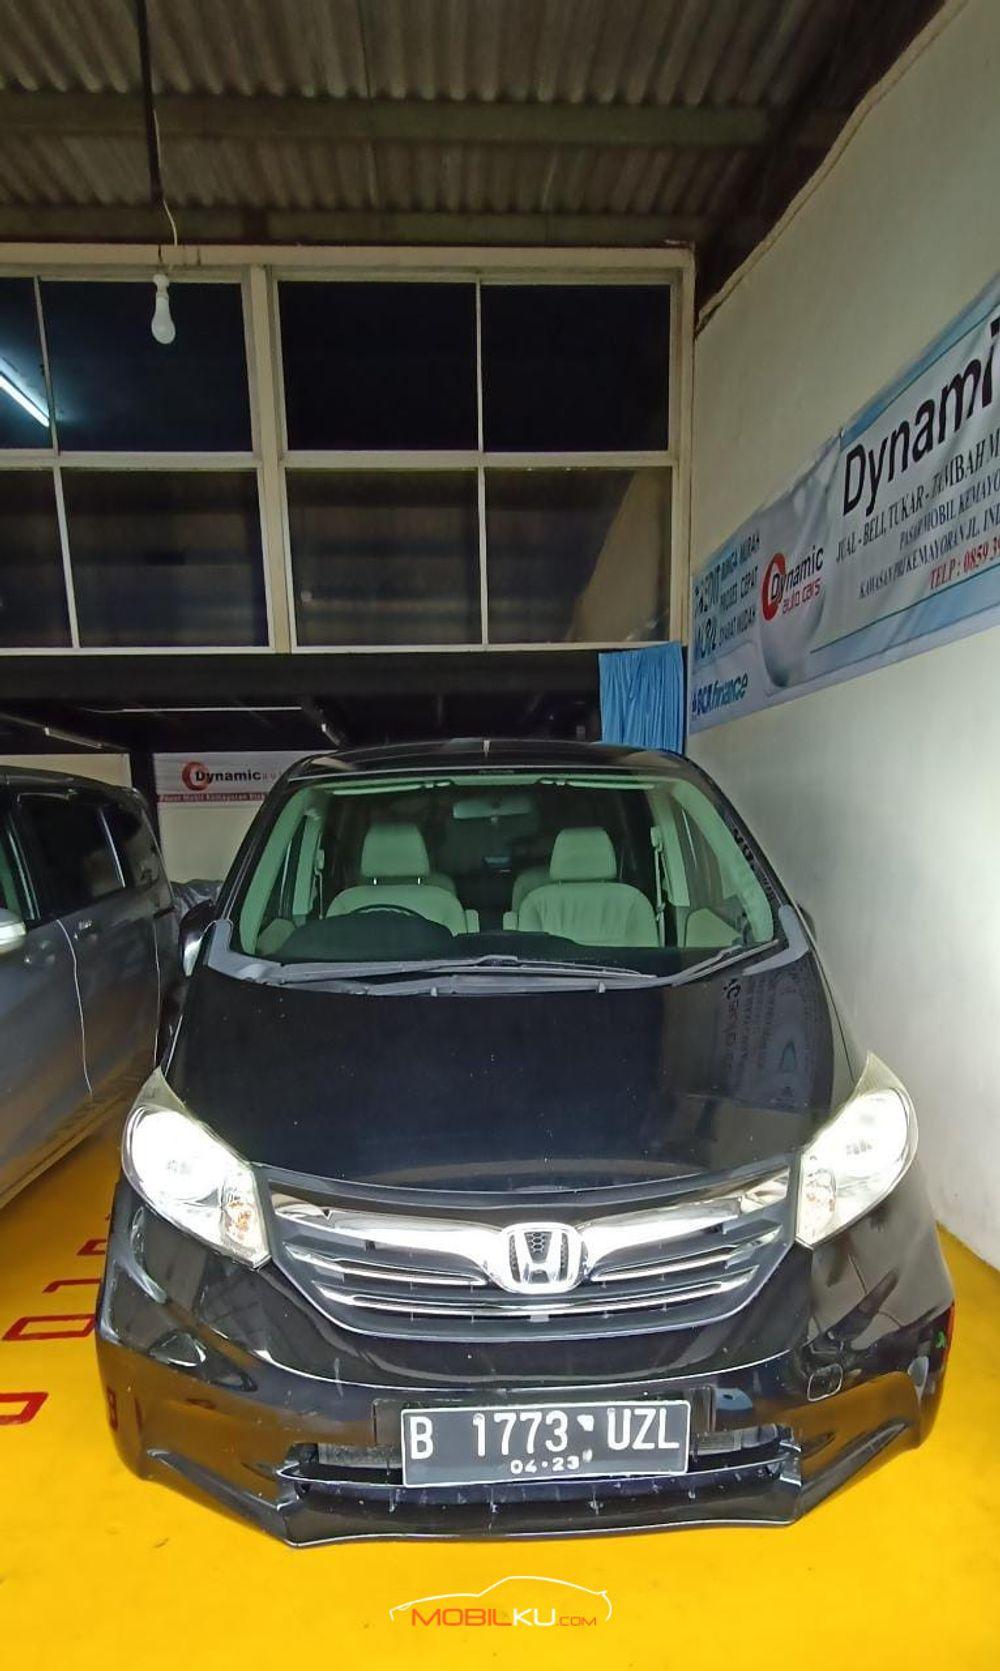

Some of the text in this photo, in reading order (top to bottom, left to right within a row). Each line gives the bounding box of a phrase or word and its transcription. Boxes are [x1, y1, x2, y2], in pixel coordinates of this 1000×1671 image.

[889, 485, 924, 529] TUKAR
[924, 500, 956, 532] MOBIL
[771, 545, 824, 604] Dynamic
[195, 769, 262, 784] Dynamic
[409, 1408, 681, 1460] B 1773 UZL
